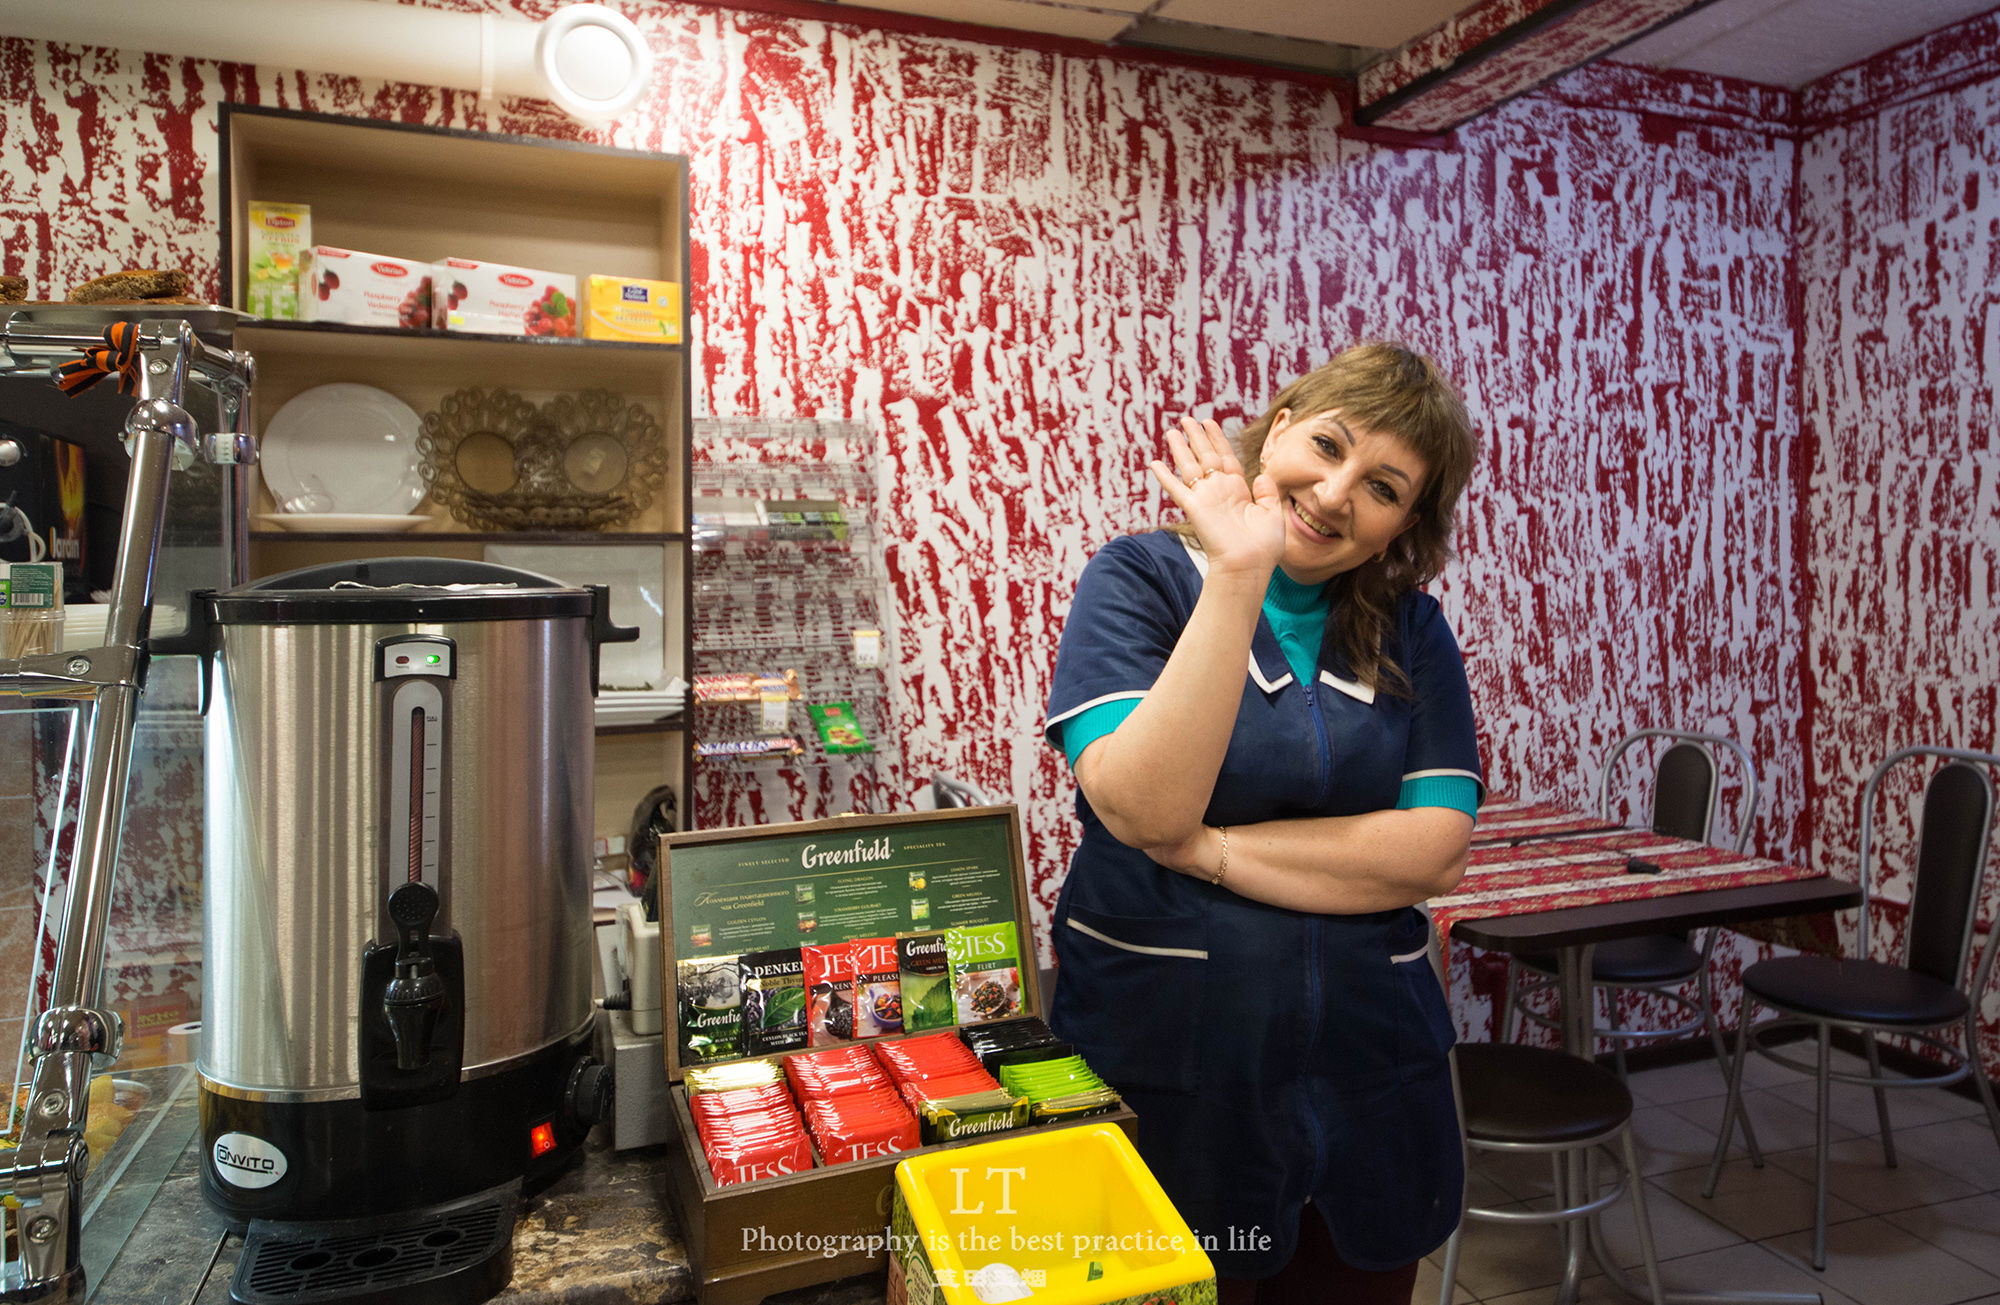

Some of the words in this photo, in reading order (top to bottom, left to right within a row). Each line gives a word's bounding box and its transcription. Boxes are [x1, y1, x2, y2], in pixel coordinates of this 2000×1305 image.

[801, 836, 892, 869] Greenfield
[732, 899, 765, 911] Greenfield
[962, 932, 1006, 957] TESS
[977, 963, 997, 971] FLIRT
[950, 1111, 1014, 1138] Greenfield
